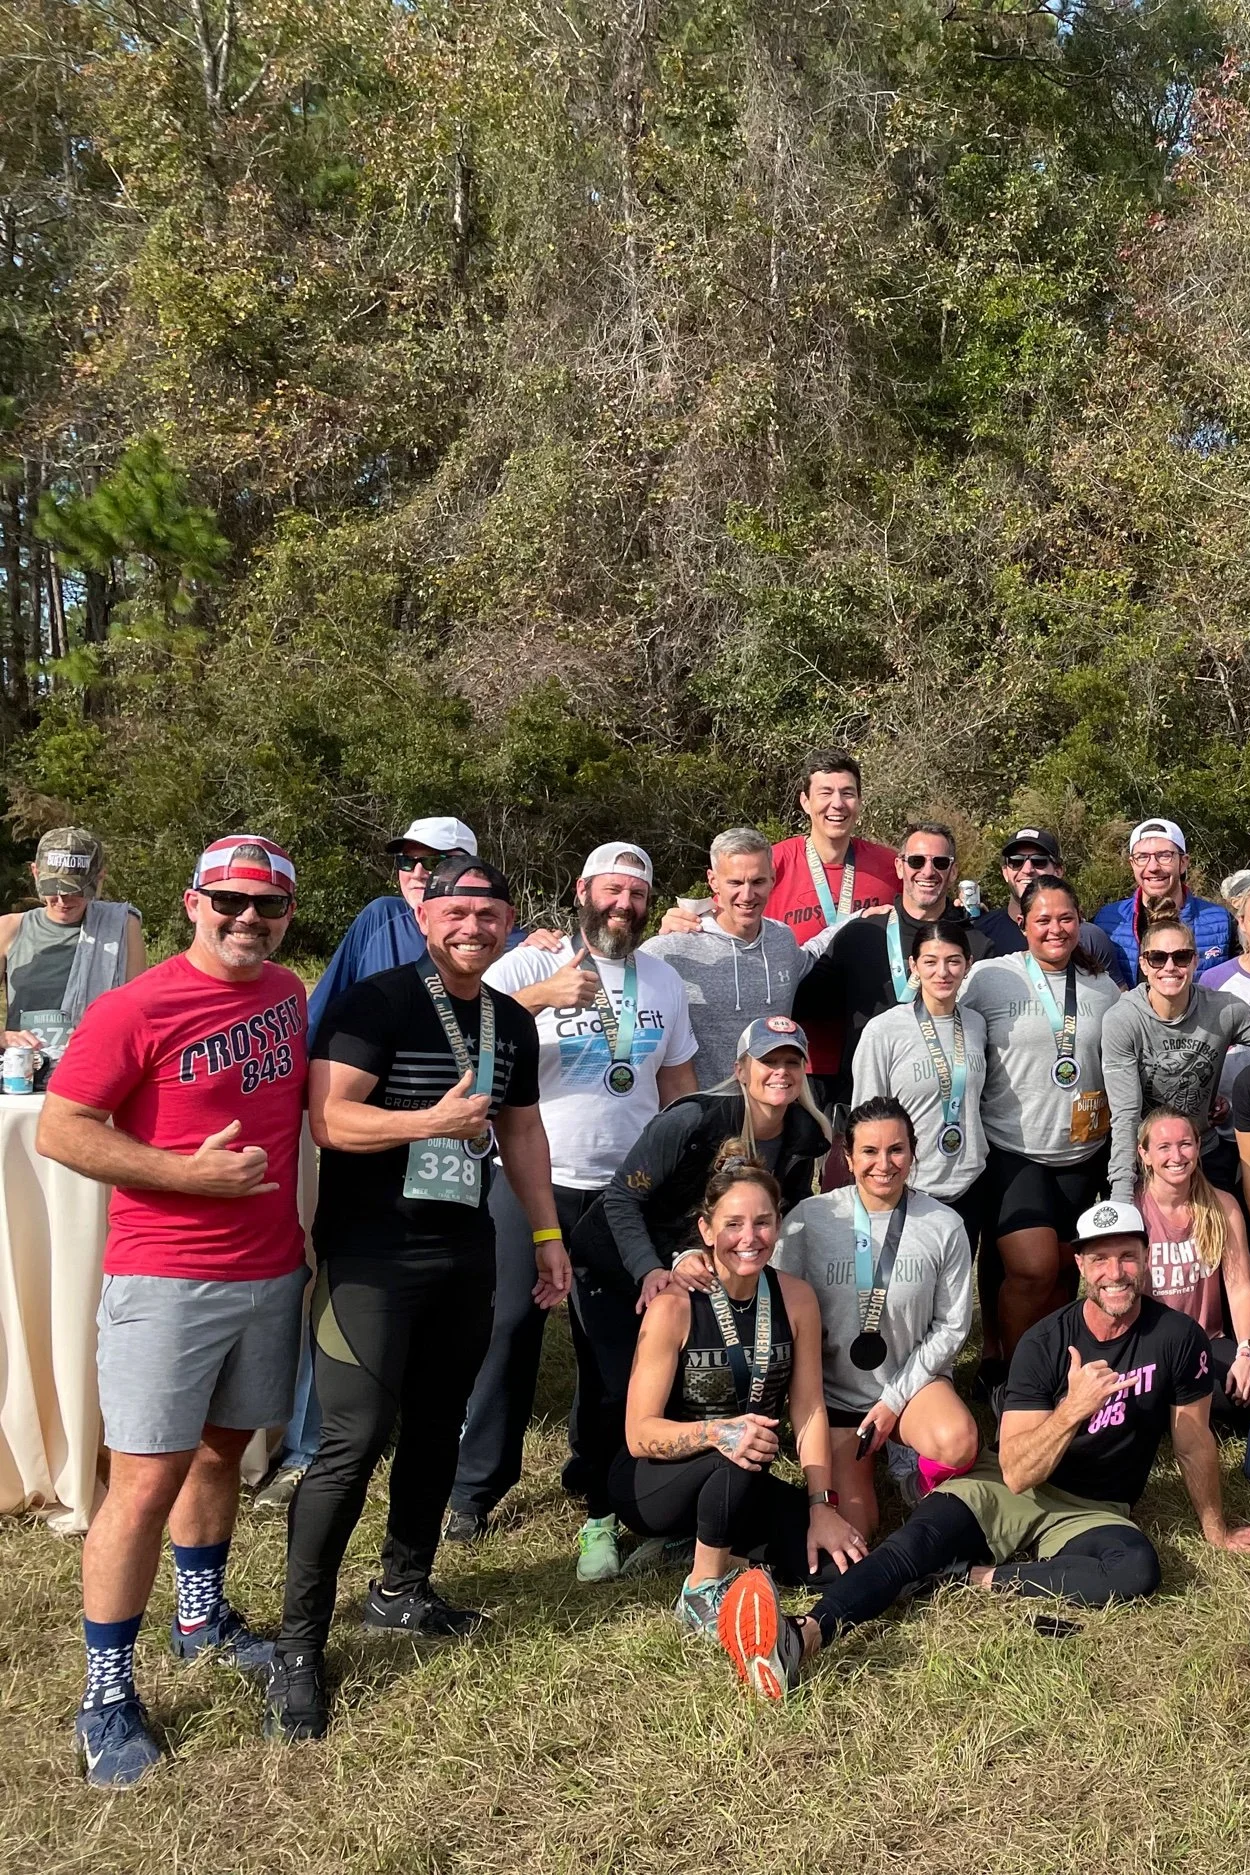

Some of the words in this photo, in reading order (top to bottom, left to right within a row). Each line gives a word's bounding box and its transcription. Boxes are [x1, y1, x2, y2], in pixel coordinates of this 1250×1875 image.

[424, 974, 447, 1000] 2022
[180, 994, 303, 1084] CROSSFIT
[920, 1020, 938, 1041] 2022
[1063, 1015, 1077, 1035] 2022
[241, 1042, 294, 1095] 843
[966, 1053, 986, 1074] RUN
[417, 1152, 476, 1187] 328
[895, 1258, 924, 1283] RUN
[713, 1299, 740, 1348] BUFFALO
[755, 1297, 771, 1354] DECEMBER
[749, 1376, 766, 1403] 2022
[1087, 1401, 1127, 1435] 843
